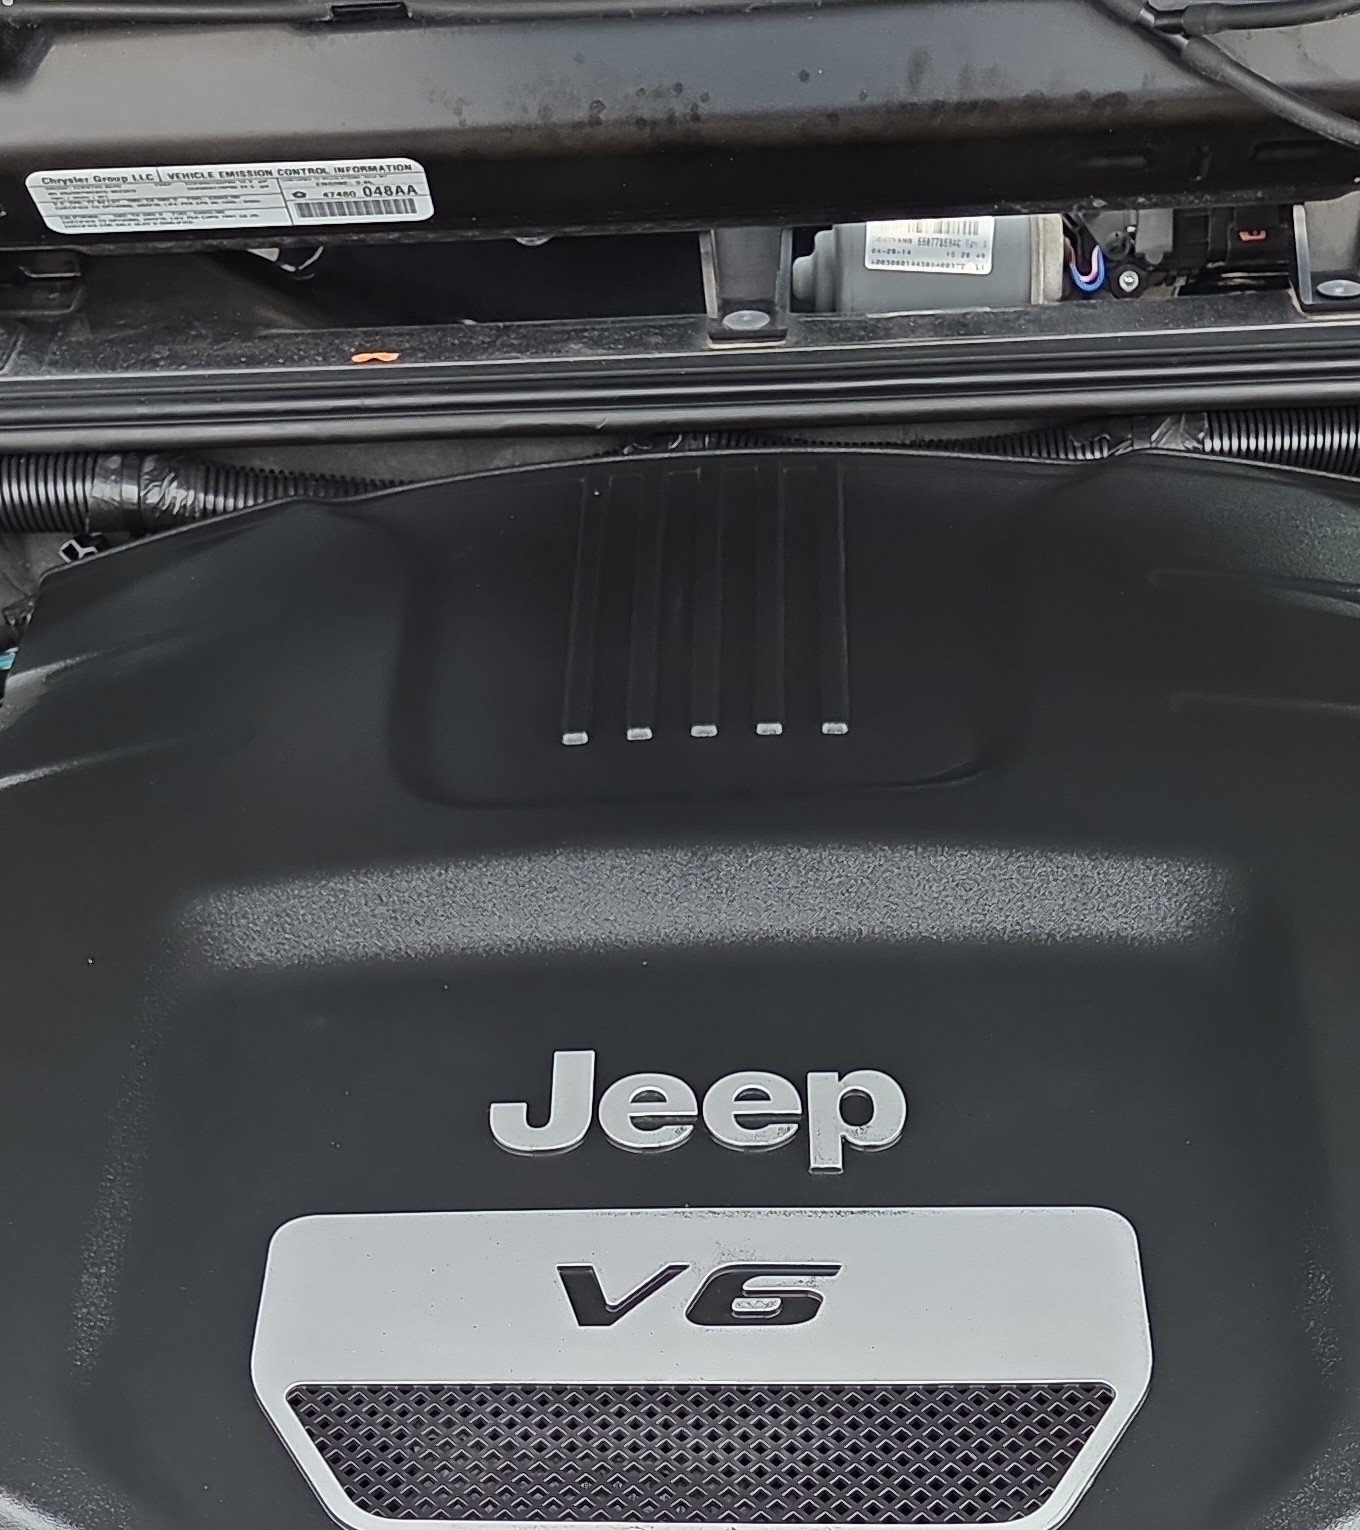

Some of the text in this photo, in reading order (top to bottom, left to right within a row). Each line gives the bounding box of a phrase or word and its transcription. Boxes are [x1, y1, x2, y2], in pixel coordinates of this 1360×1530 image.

[42, 173, 154, 186] Chrysler Group LLC
[168, 164, 412, 180] VEHICLE EMISSION CONTROL INFORMATION
[362, 185, 418, 198] 048AA
[489, 1049, 907, 1176] Jeep
[556, 1263, 841, 1327] V6
